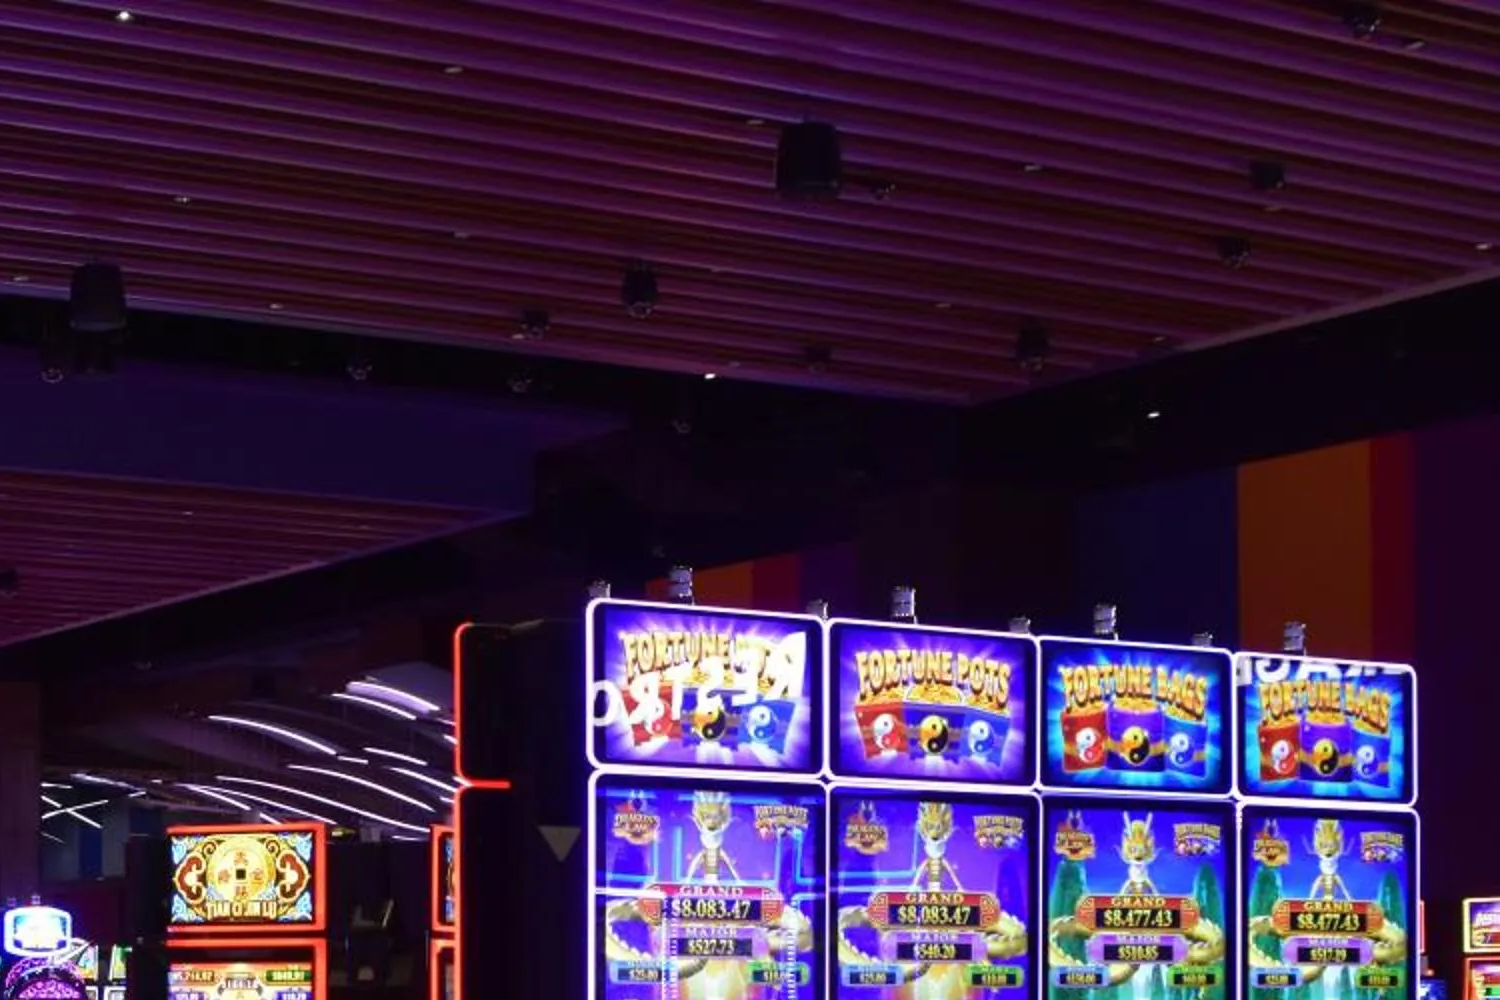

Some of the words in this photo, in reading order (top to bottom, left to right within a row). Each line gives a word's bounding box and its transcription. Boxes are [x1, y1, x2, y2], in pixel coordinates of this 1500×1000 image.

[619, 631, 730, 684] FORTUNE
[855, 648, 953, 700] FORTUNE
[957, 653, 1011, 708] POTS
[1058, 664, 1152, 713] FORTUNE
[1156, 665, 1207, 720] BAGS
[1259, 680, 1341, 725] FORTUNE
[1345, 682, 1391, 733] BAGS
[680, 886, 744, 897] GRAND
[905, 893, 965, 904] GRAND
[1111, 898, 1166, 908] GRAND
[1304, 902, 1354, 912] GRAND
[685, 928, 738, 938] MAJOR
